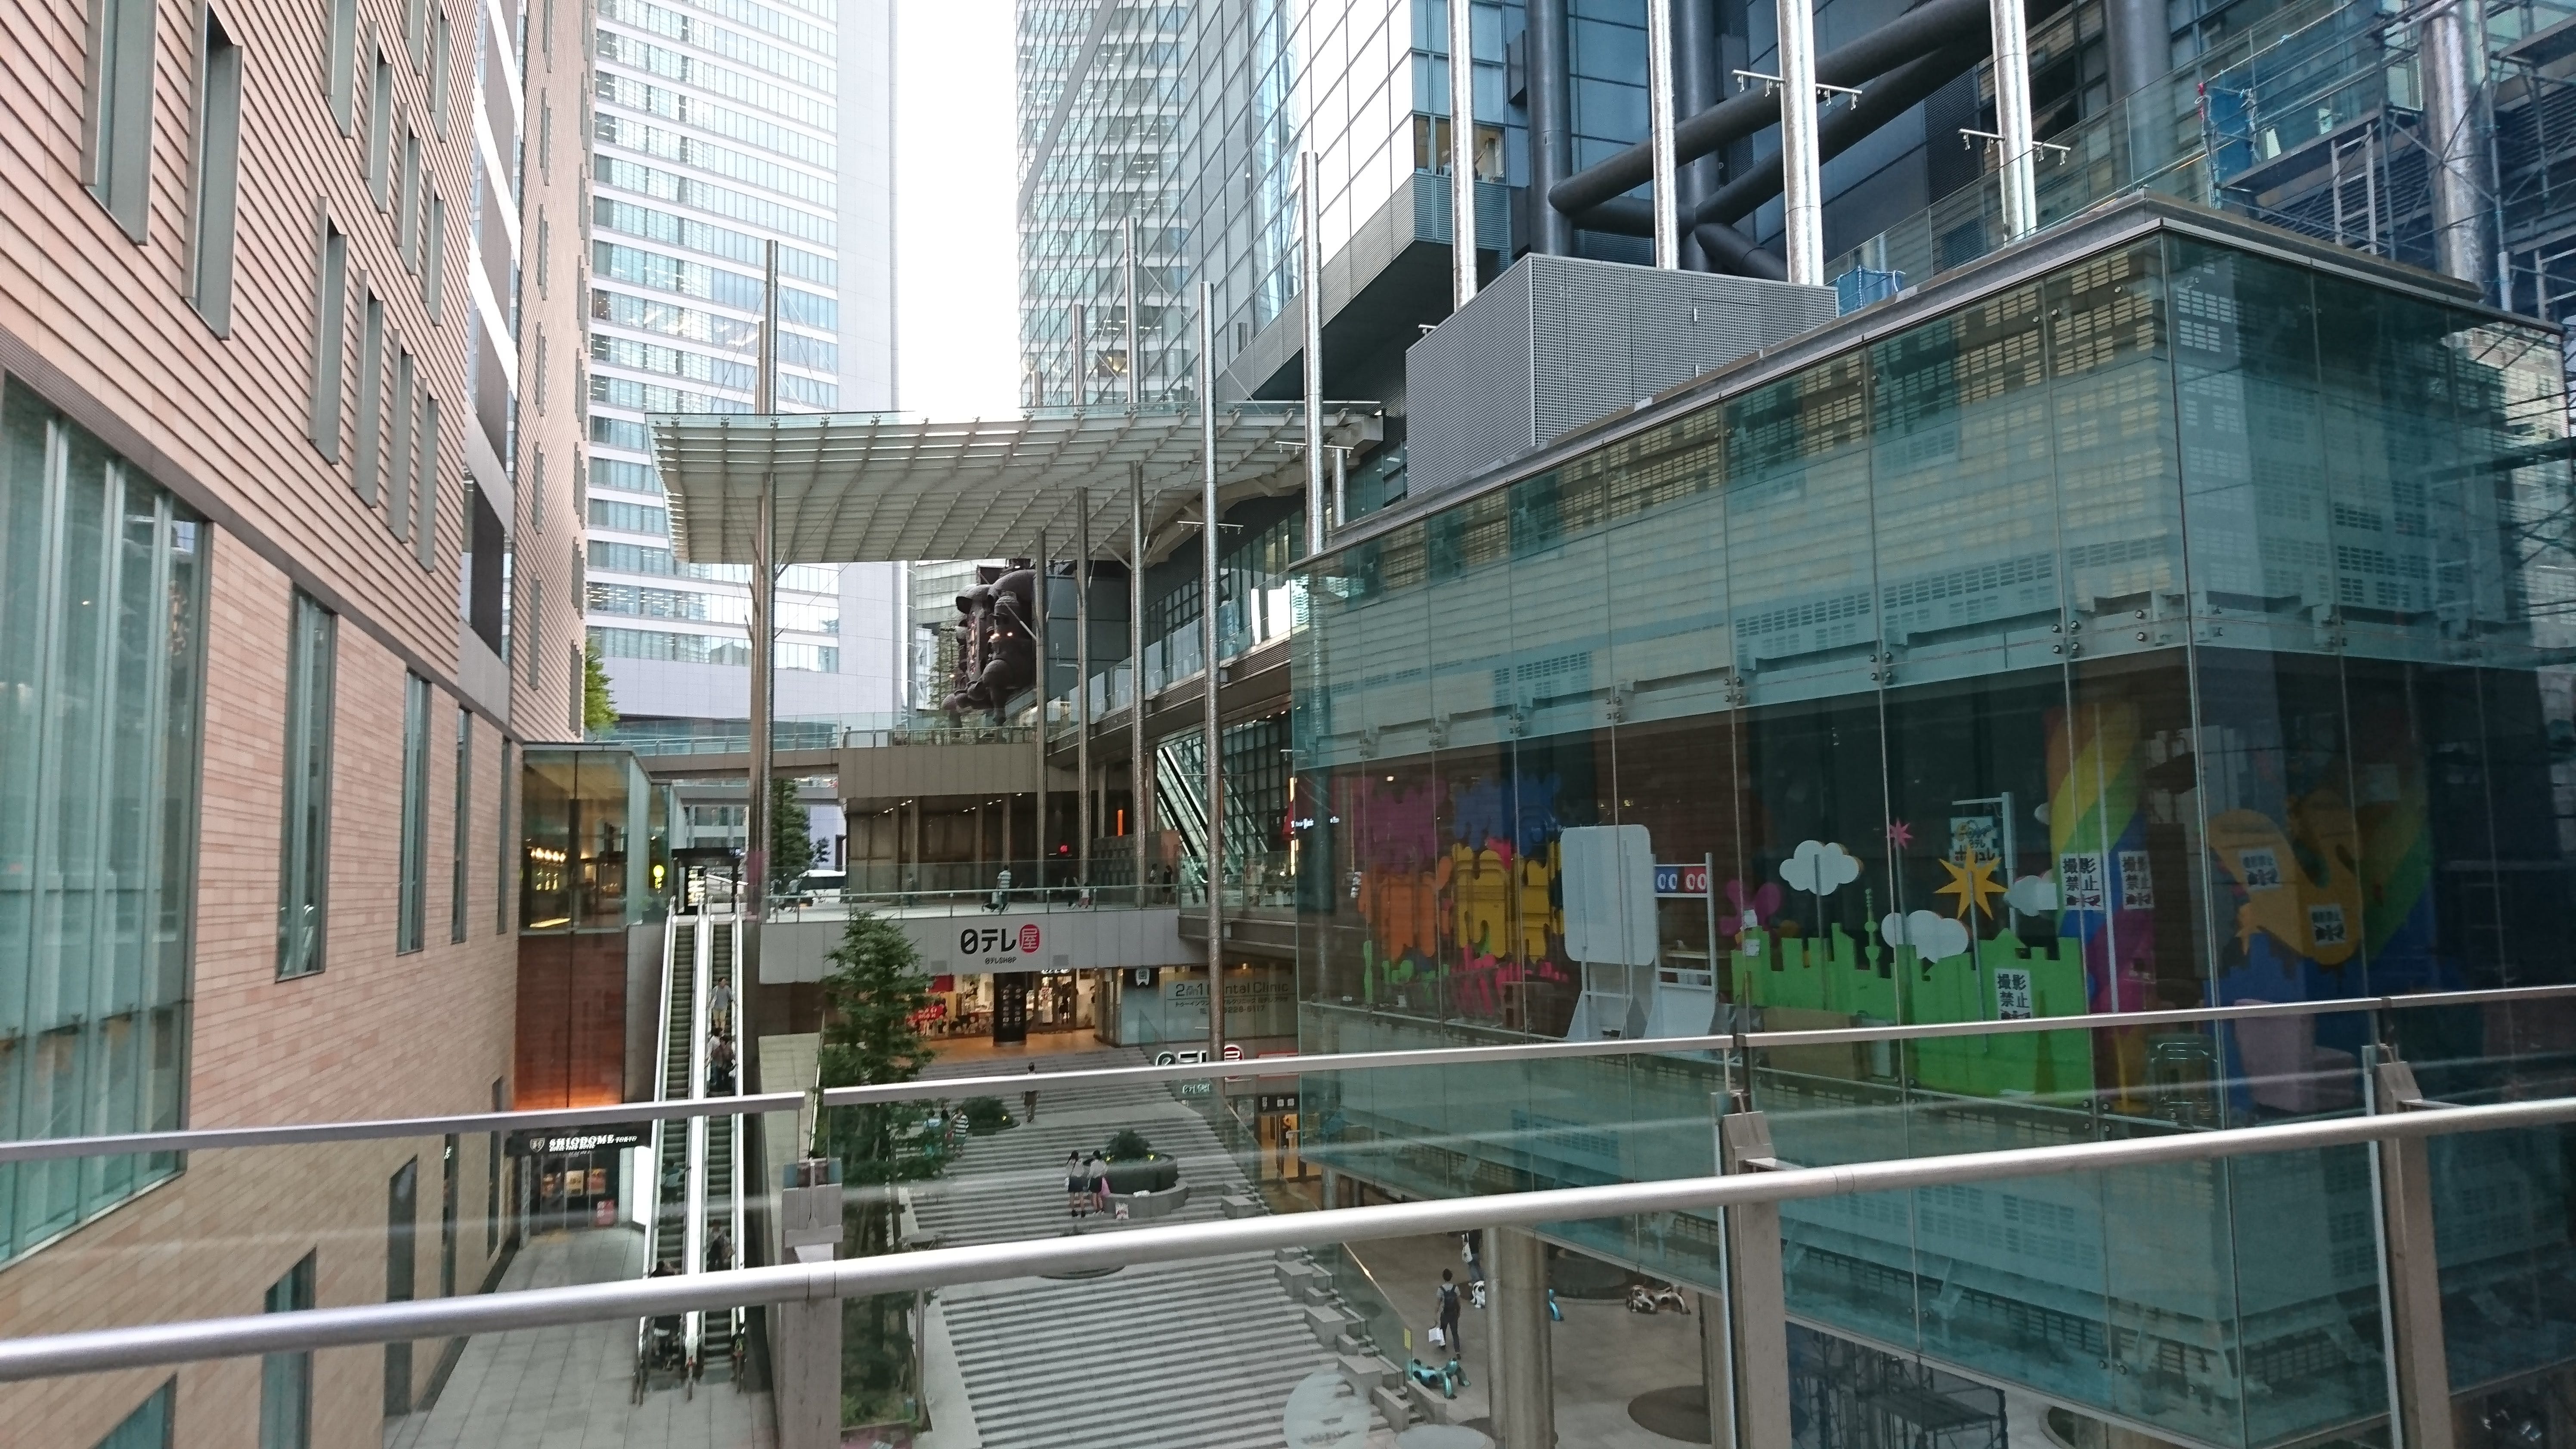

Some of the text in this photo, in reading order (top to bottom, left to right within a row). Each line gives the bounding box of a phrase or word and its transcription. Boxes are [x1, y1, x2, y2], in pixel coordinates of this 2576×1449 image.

[2063, 858, 2097, 874] 撮影
[1657, 873, 1706, 890] 00 00
[2065, 875, 2101, 891] 禁止
[1997, 973, 2026, 990] 撮影
[2000, 991, 2029, 1007] 禁止
[549, 1134, 614, 1146] SHIODOME
